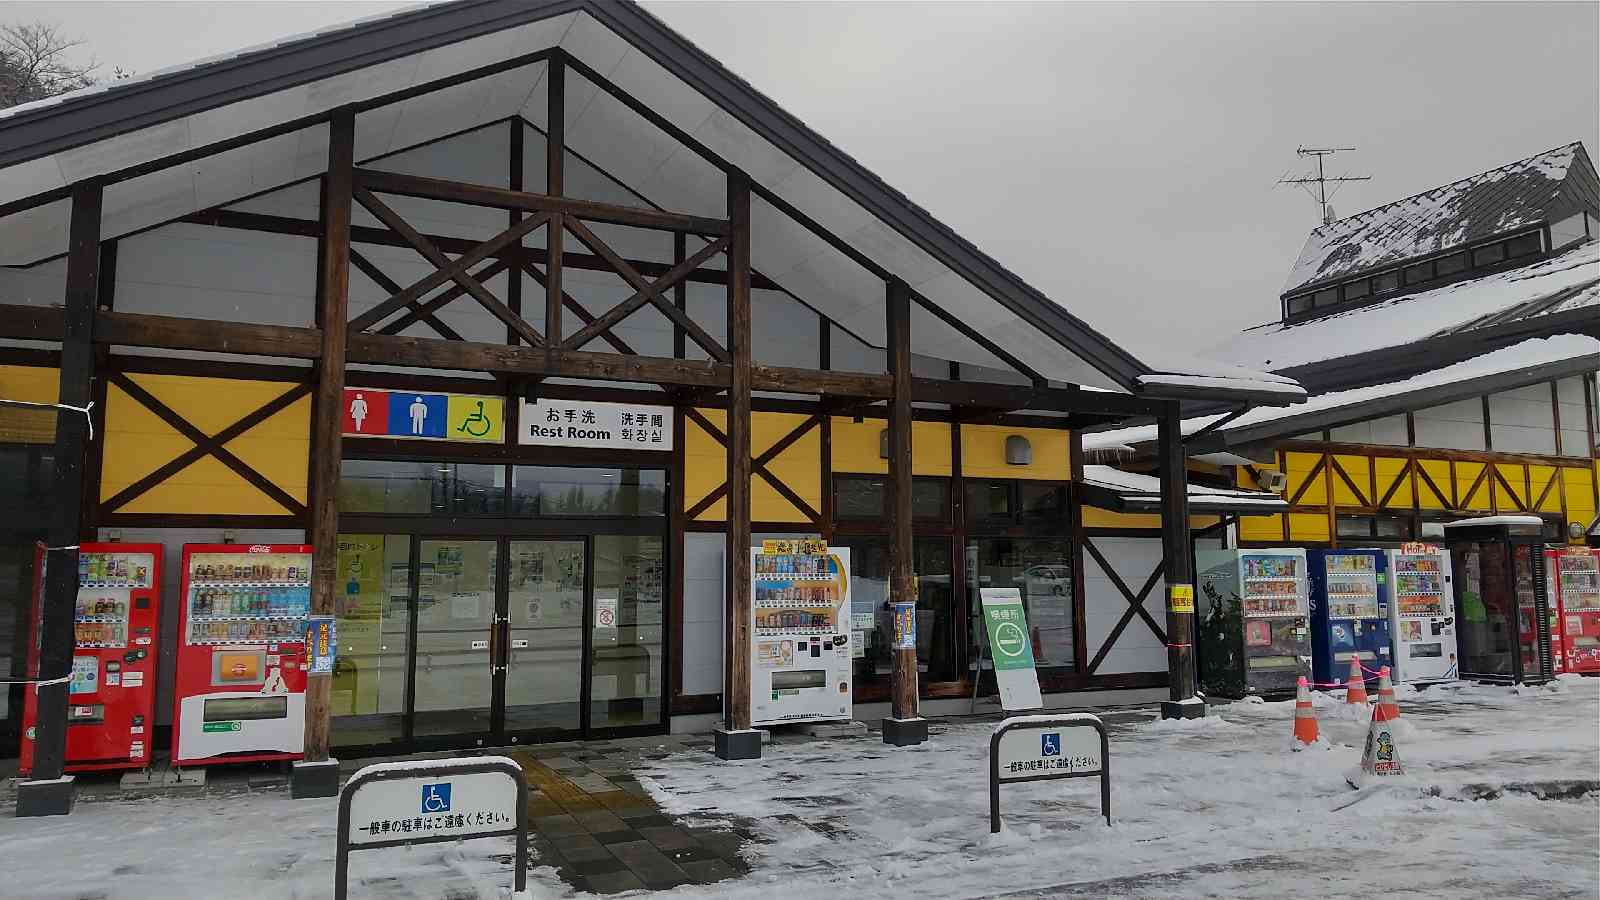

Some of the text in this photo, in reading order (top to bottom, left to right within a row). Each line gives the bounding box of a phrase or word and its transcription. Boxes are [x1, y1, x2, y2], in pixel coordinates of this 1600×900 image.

[546, 407, 596, 424] お手洗
[621, 412, 663, 428] 洗手間
[530, 424, 611, 440] Rest Room
[621, 428, 663, 443] 화장실
[359, 811, 511, 836] 一般車の駐車はご遠慮ください。
